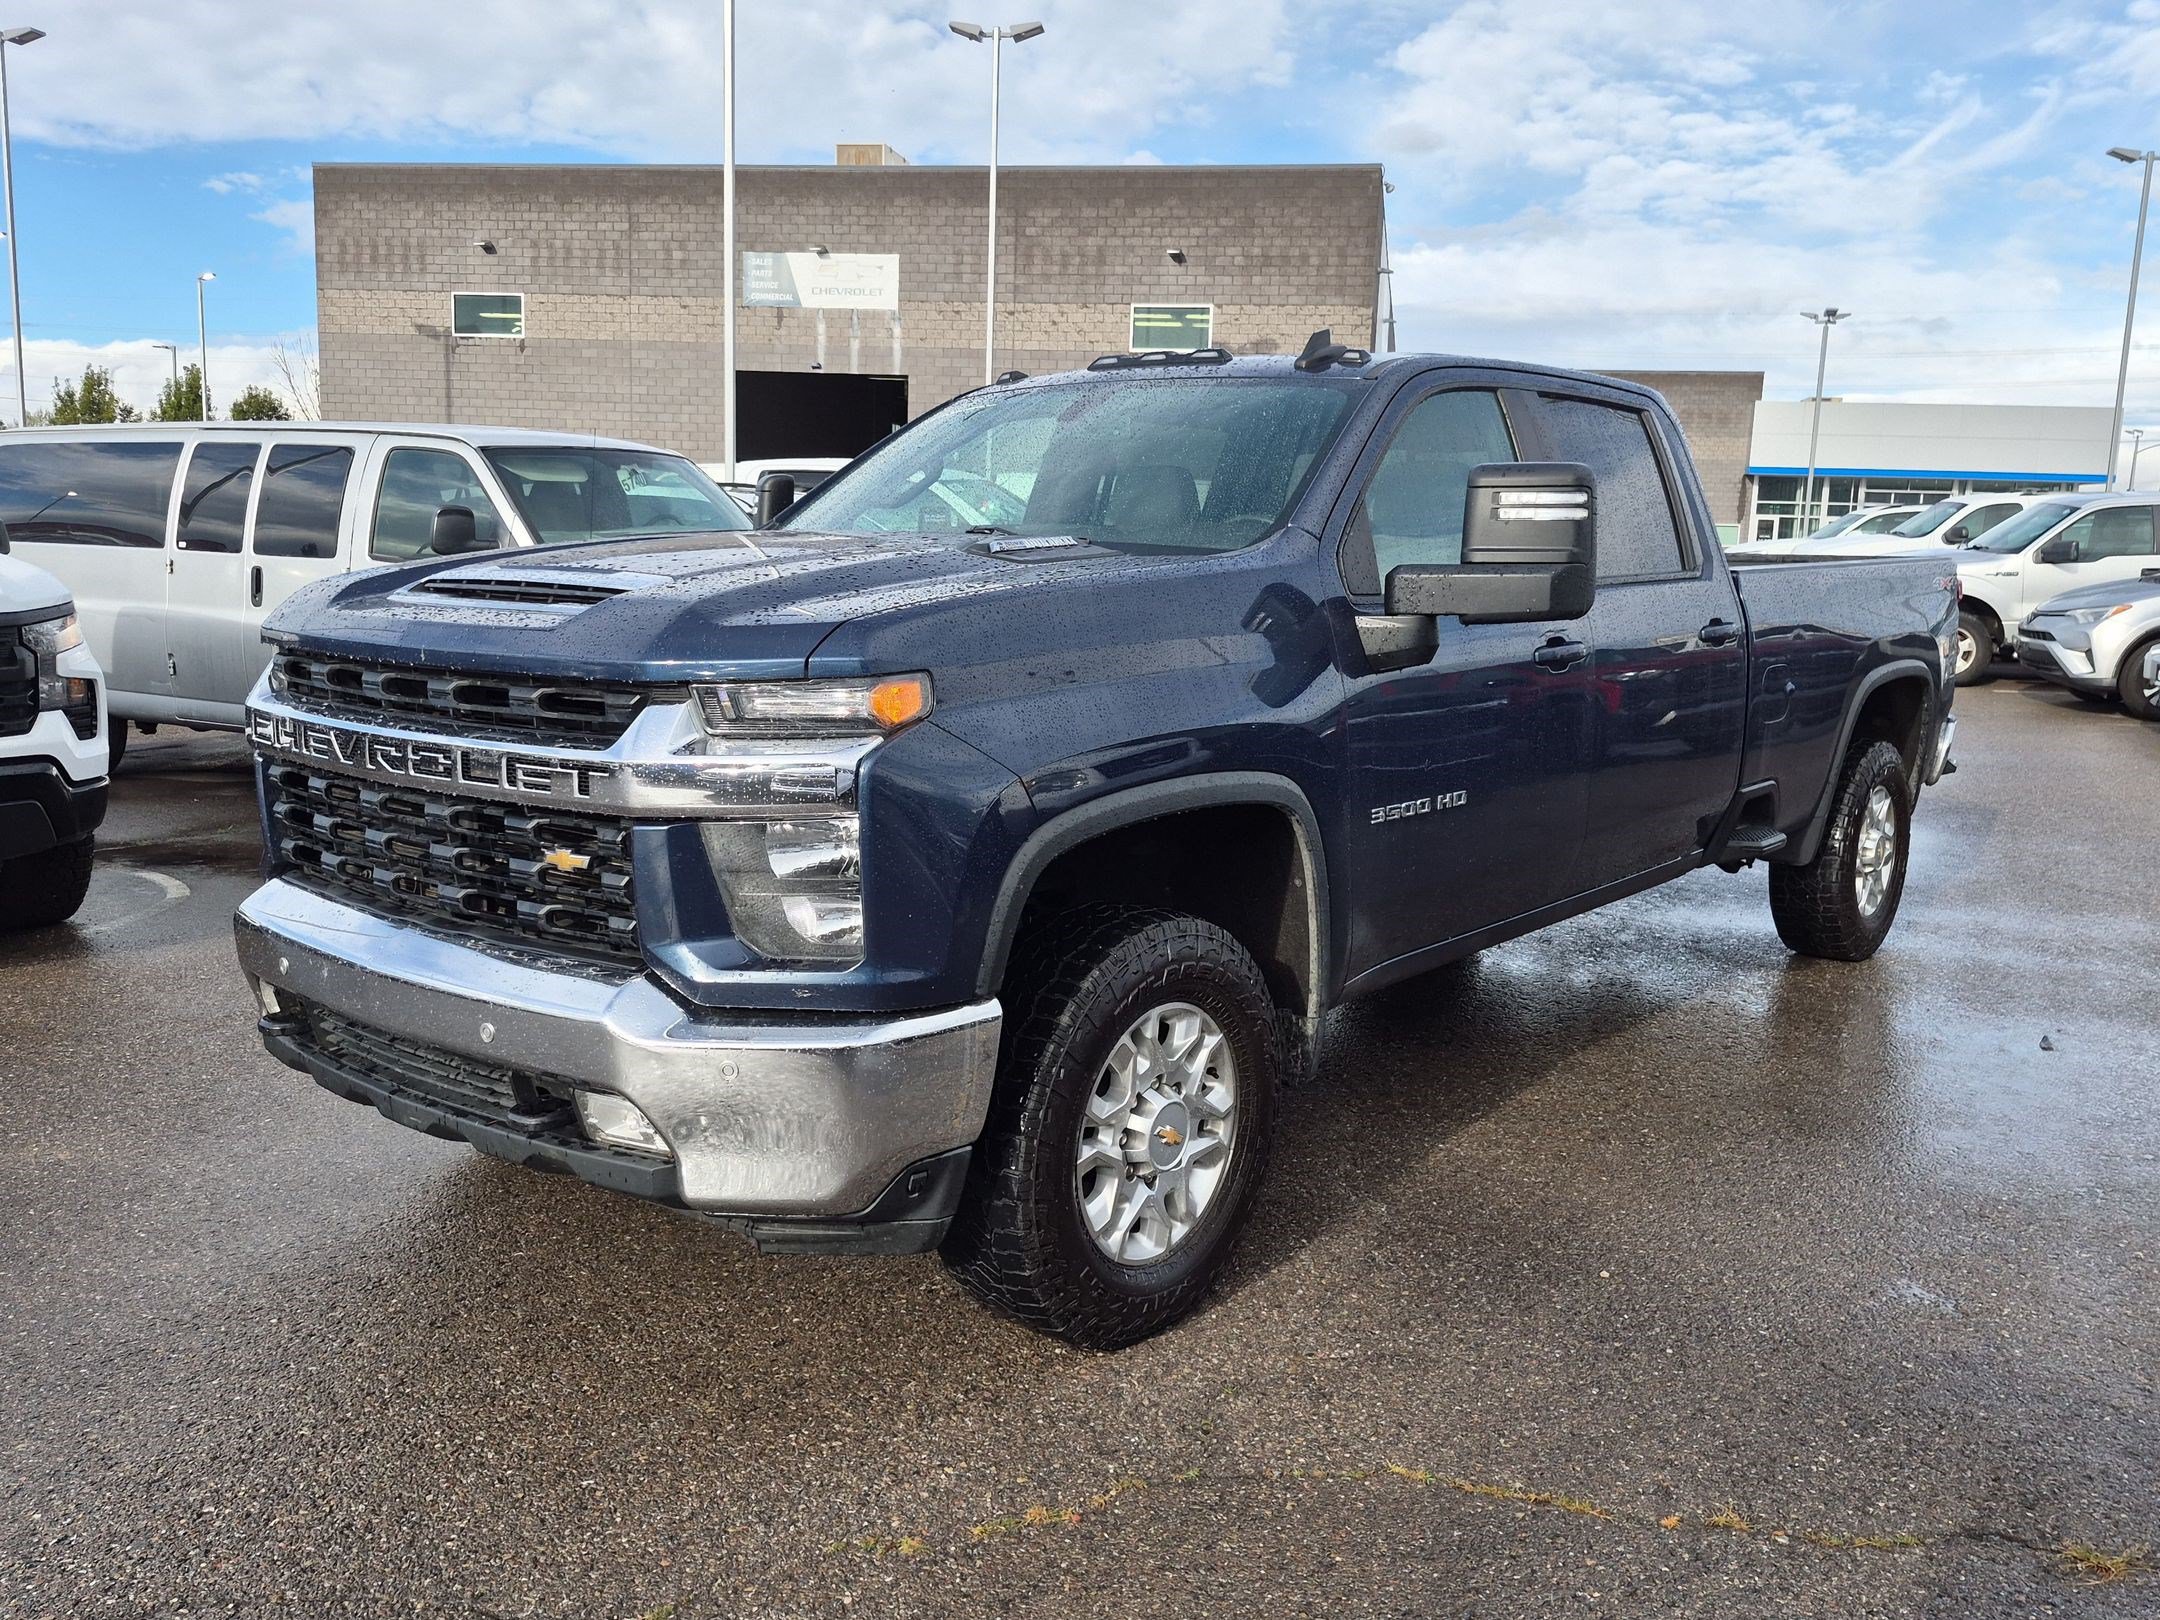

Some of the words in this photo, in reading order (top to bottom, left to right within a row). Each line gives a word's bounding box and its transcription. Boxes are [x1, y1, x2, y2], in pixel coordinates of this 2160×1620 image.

[751, 257, 773, 266] SALES
[751, 269, 773, 278] PARTS
[751, 281, 779, 289] SERVICE
[750, 292, 794, 301] COMMERCIAL
[811, 287, 884, 297] CHEVROLET
[250, 708, 610, 799] CHEVROLET
[1370, 797, 1431, 824] 3500
[1437, 790, 1468, 811] HD
